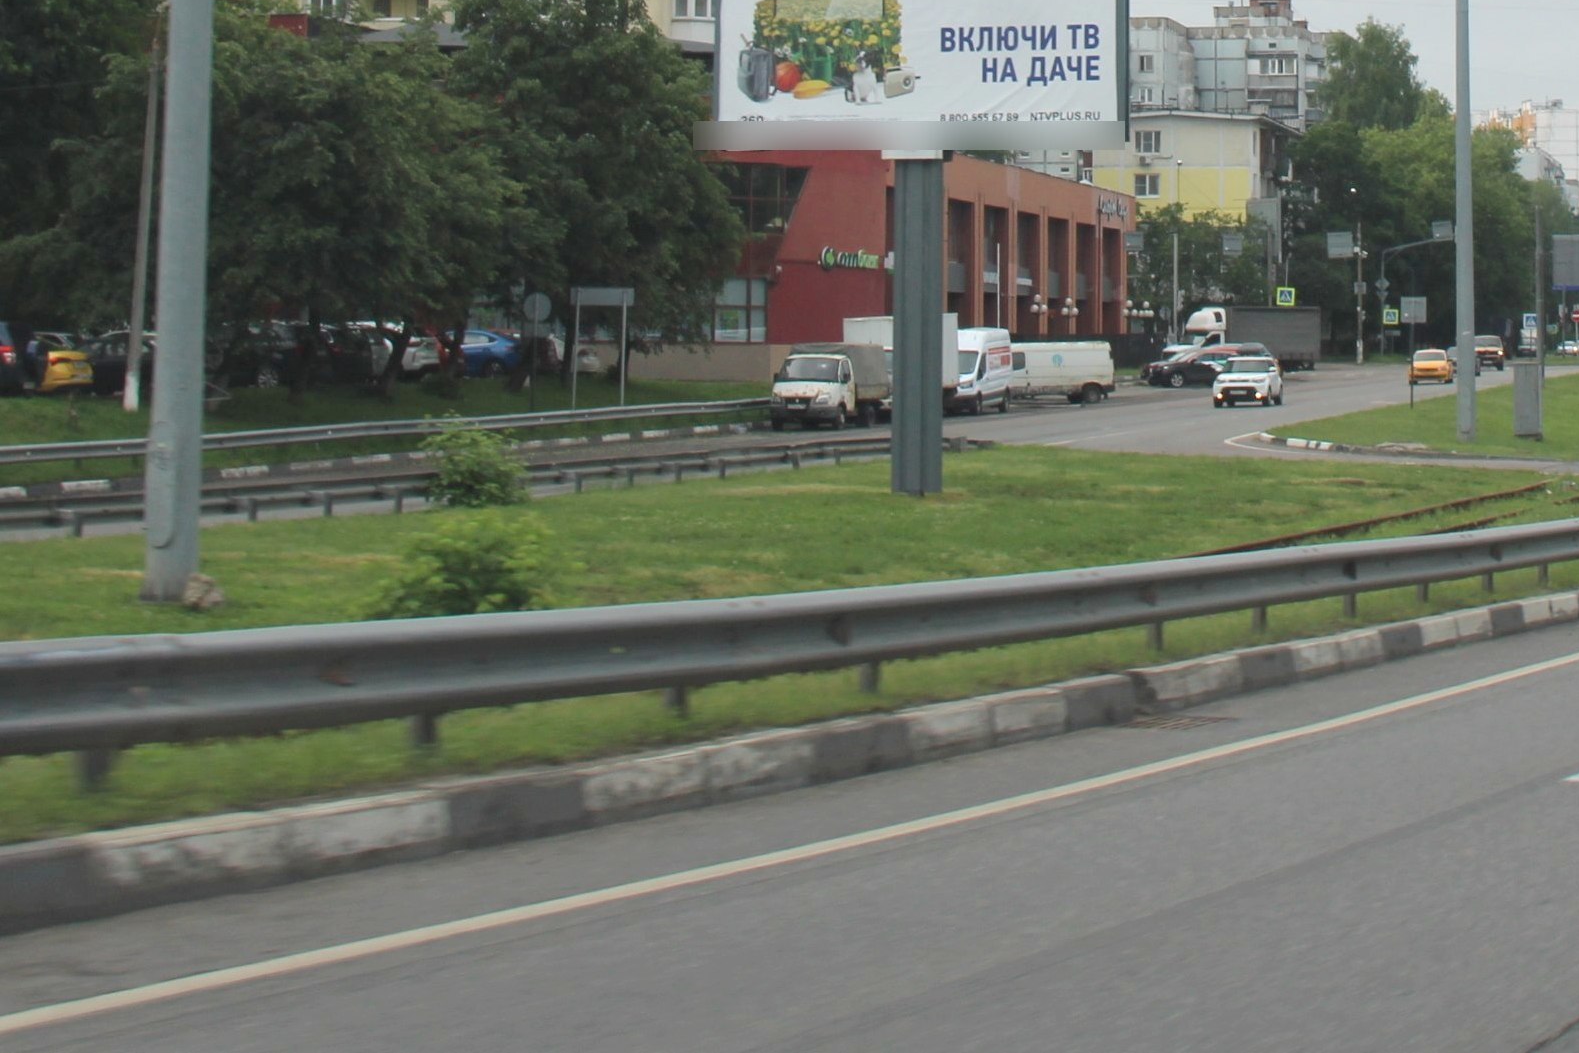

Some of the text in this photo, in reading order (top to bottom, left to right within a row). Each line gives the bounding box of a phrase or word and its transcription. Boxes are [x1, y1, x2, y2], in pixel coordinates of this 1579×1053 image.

[940, 24, 1100, 52] ВКЛЮЧИ ТВ
[981, 55, 1101, 86] НА ДАЧЕ
[1030, 111, 1101, 121] NTVPLUS.RU
